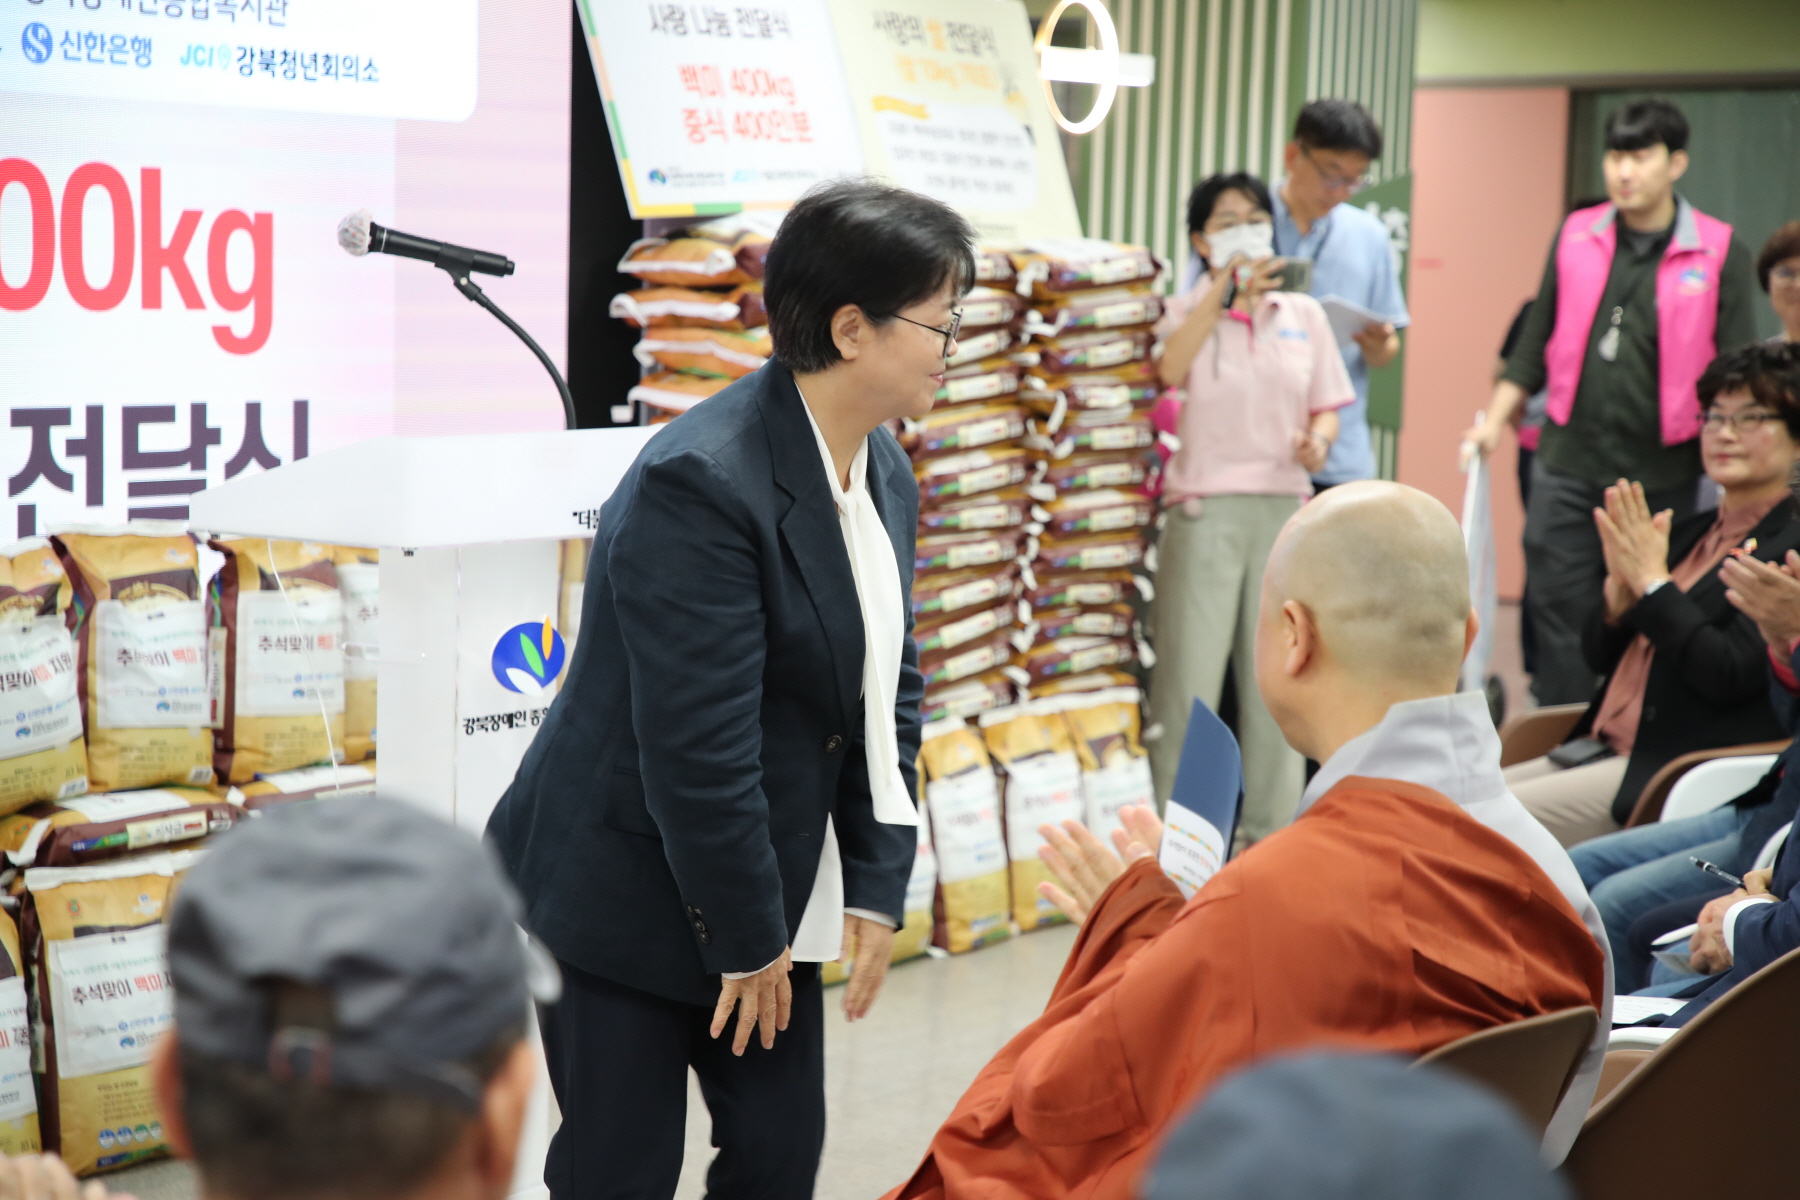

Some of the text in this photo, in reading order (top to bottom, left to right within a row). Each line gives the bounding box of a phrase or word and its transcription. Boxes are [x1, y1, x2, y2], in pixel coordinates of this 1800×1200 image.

[60, 29, 152, 67] 신한은행
[180, 44, 379, 82] JCI 강북청년회의소
[729, 67, 797, 106] 400kg
[462, 710, 527, 736] 강북장애인
[72, 978, 133, 1006] 추석맞이
[133, 973, 164, 994] 백미
